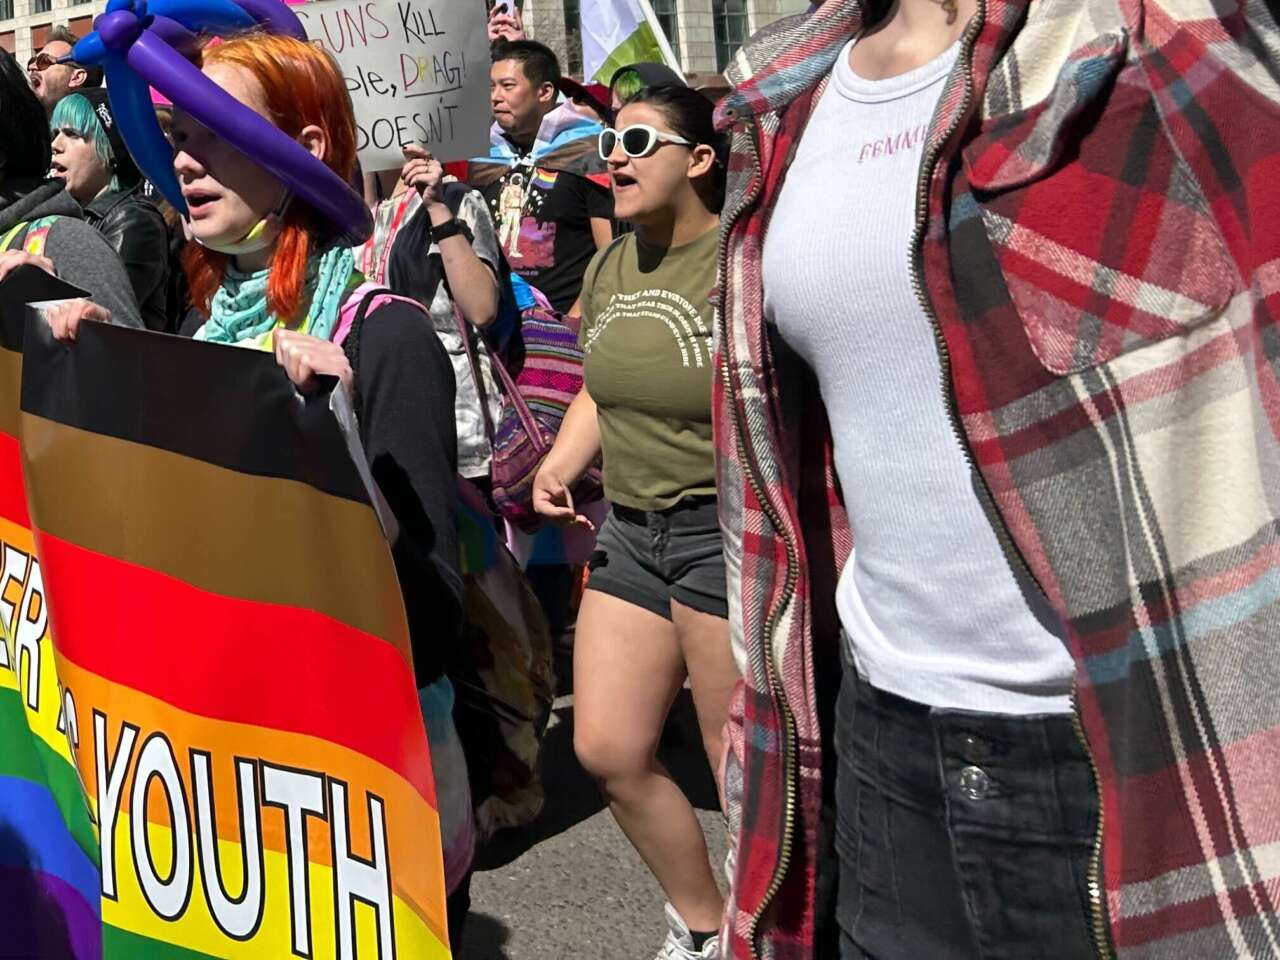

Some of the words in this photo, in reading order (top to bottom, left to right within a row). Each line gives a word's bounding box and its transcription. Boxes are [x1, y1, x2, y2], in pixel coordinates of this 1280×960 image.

[397, 1, 446, 45] KILL
[642, 289, 661, 297] AND
[92, 707, 398, 960] YOUTH
